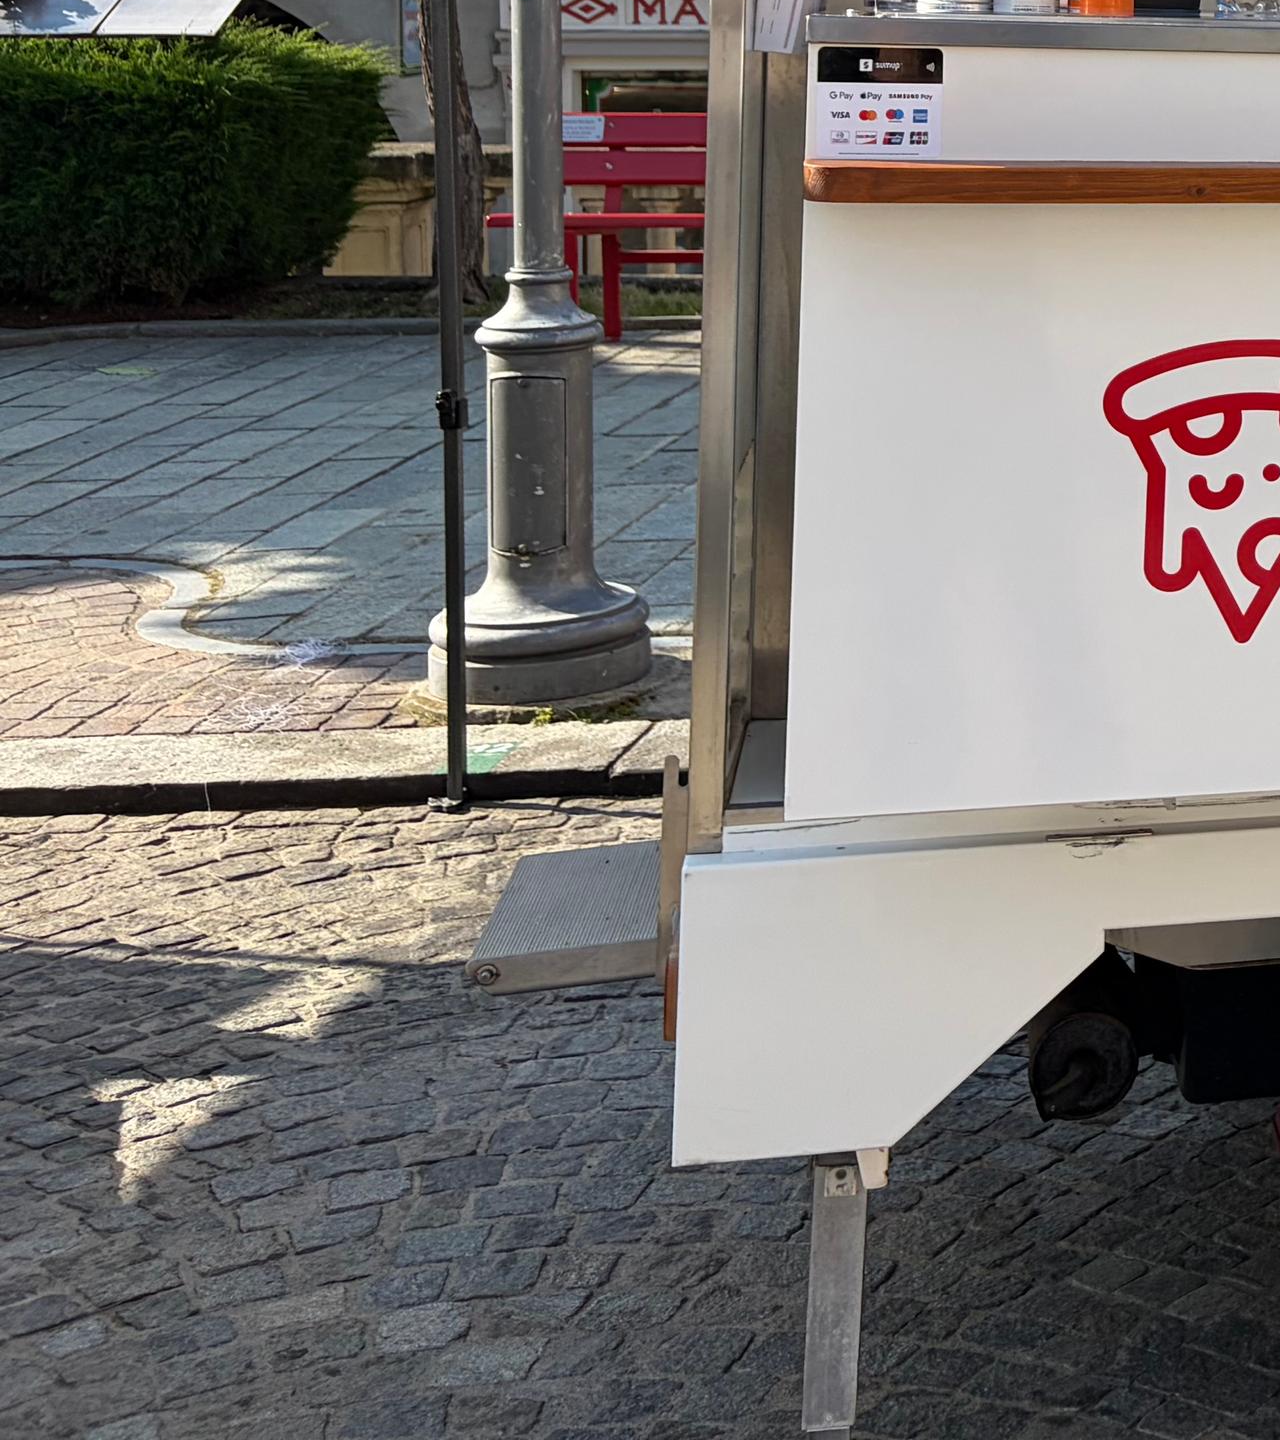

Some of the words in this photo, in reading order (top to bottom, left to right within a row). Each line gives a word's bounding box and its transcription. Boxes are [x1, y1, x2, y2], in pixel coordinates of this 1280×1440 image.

[839, 92, 854, 101] Pay
[867, 92, 883, 101] Pay
[831, 111, 850, 119] VISA
